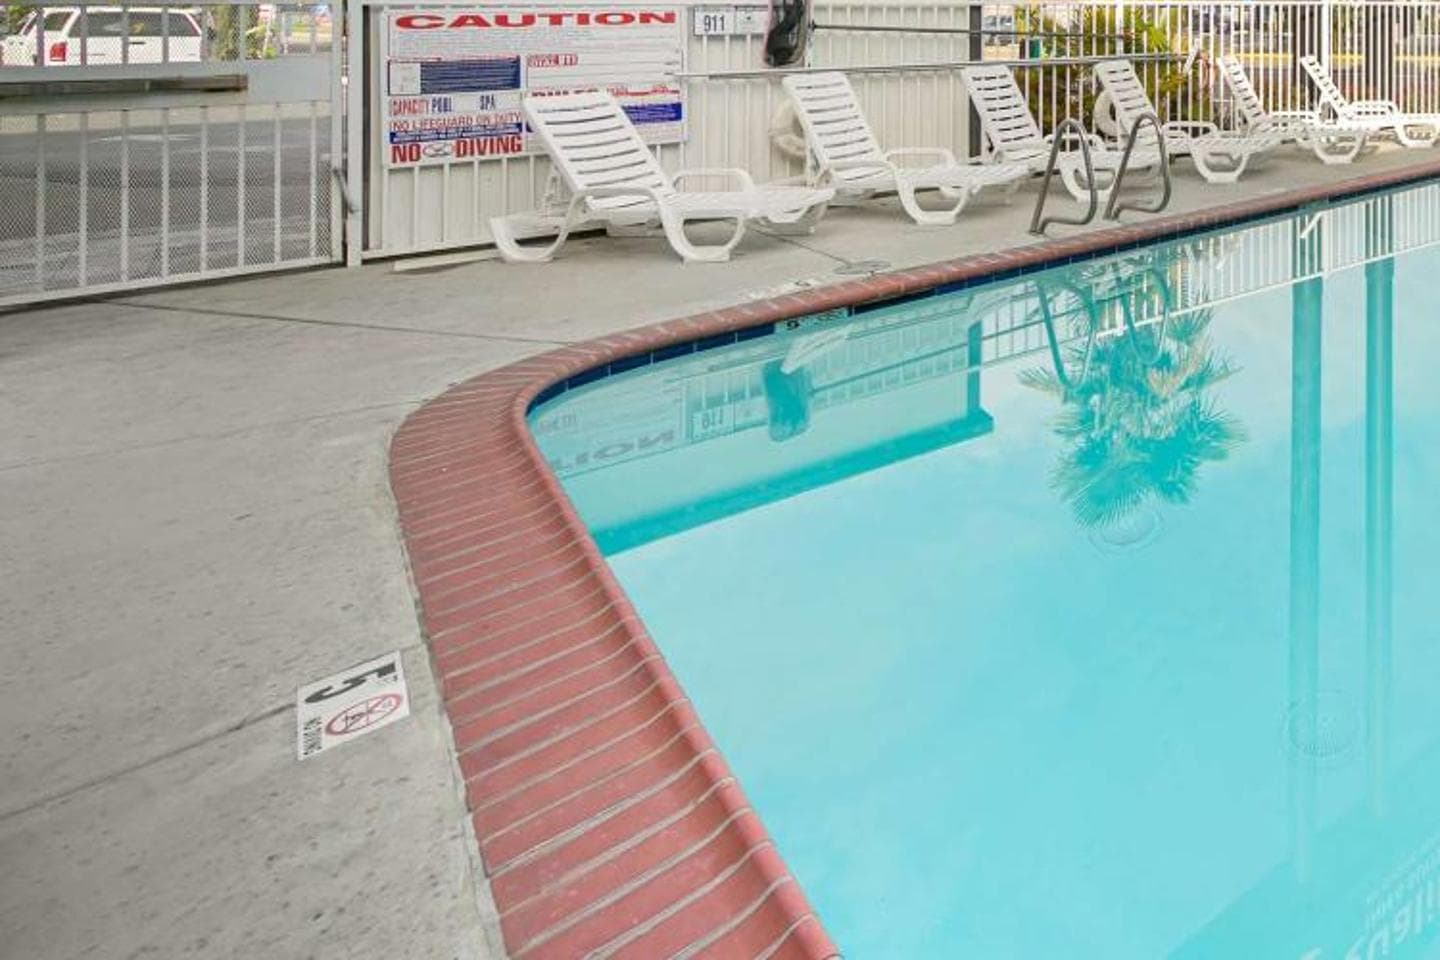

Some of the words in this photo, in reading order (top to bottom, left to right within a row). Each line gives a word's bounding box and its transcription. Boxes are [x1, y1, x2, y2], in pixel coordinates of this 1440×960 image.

[396, 12, 676, 29] CAUTION
[704, 15, 725, 32] 911
[480, 94, 496, 111] SPA
[392, 143, 421, 163] NO
[455, 135, 522, 158] DIVING
